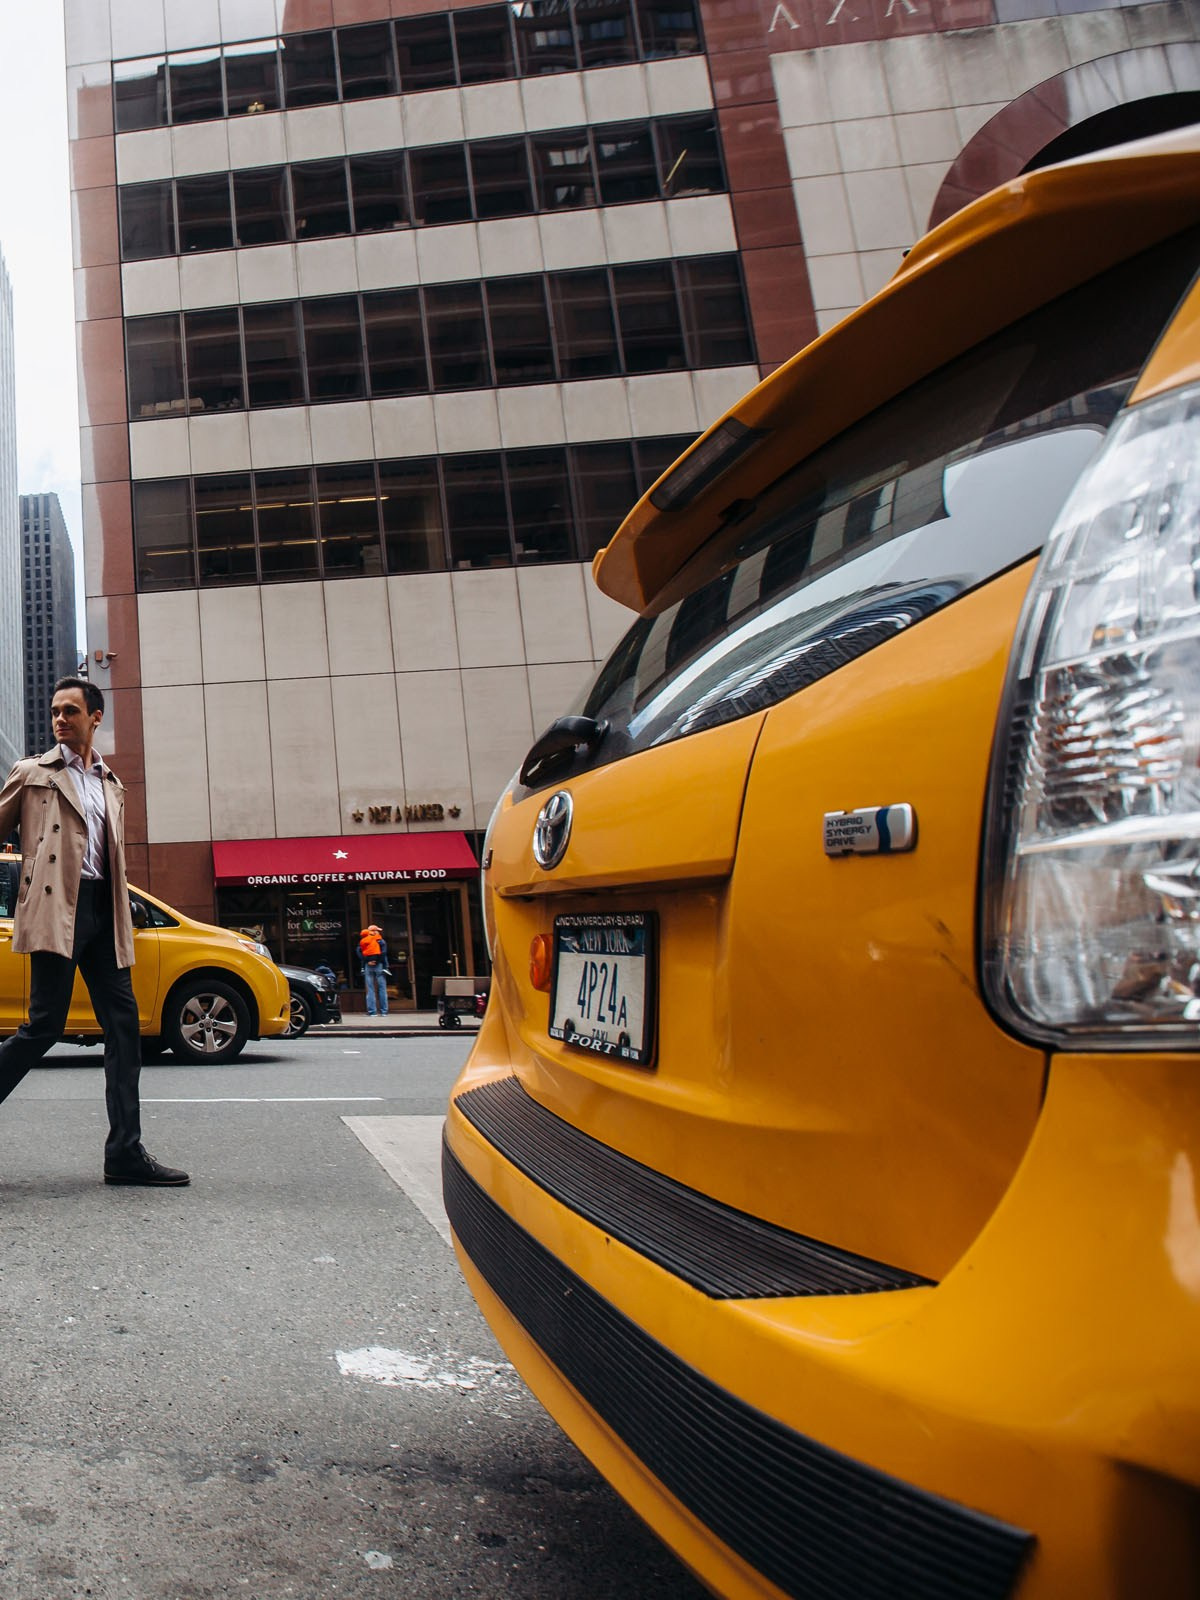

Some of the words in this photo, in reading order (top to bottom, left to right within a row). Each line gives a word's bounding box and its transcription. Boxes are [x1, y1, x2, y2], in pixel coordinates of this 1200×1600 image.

[826, 816, 863, 828] HYBRID
[826, 825, 872, 838] SYNERGY
[826, 836, 855, 847] DRIVE
[247, 875, 298, 885] ORGANIC
[303, 873, 345, 883] COFFEE
[355, 870, 411, 881] NATURAL
[415, 869, 447, 879] FOOD
[286, 907, 304, 917] Not
[306, 908, 323, 917] just
[287, 920, 301, 930] for
[582, 929, 602, 952] NEW
[604, 929, 630, 953] YORK
[577, 961, 627, 1027] 4P24A
[592, 1028, 608, 1041] TAXI
[568, 1033, 617, 1054] PORT
